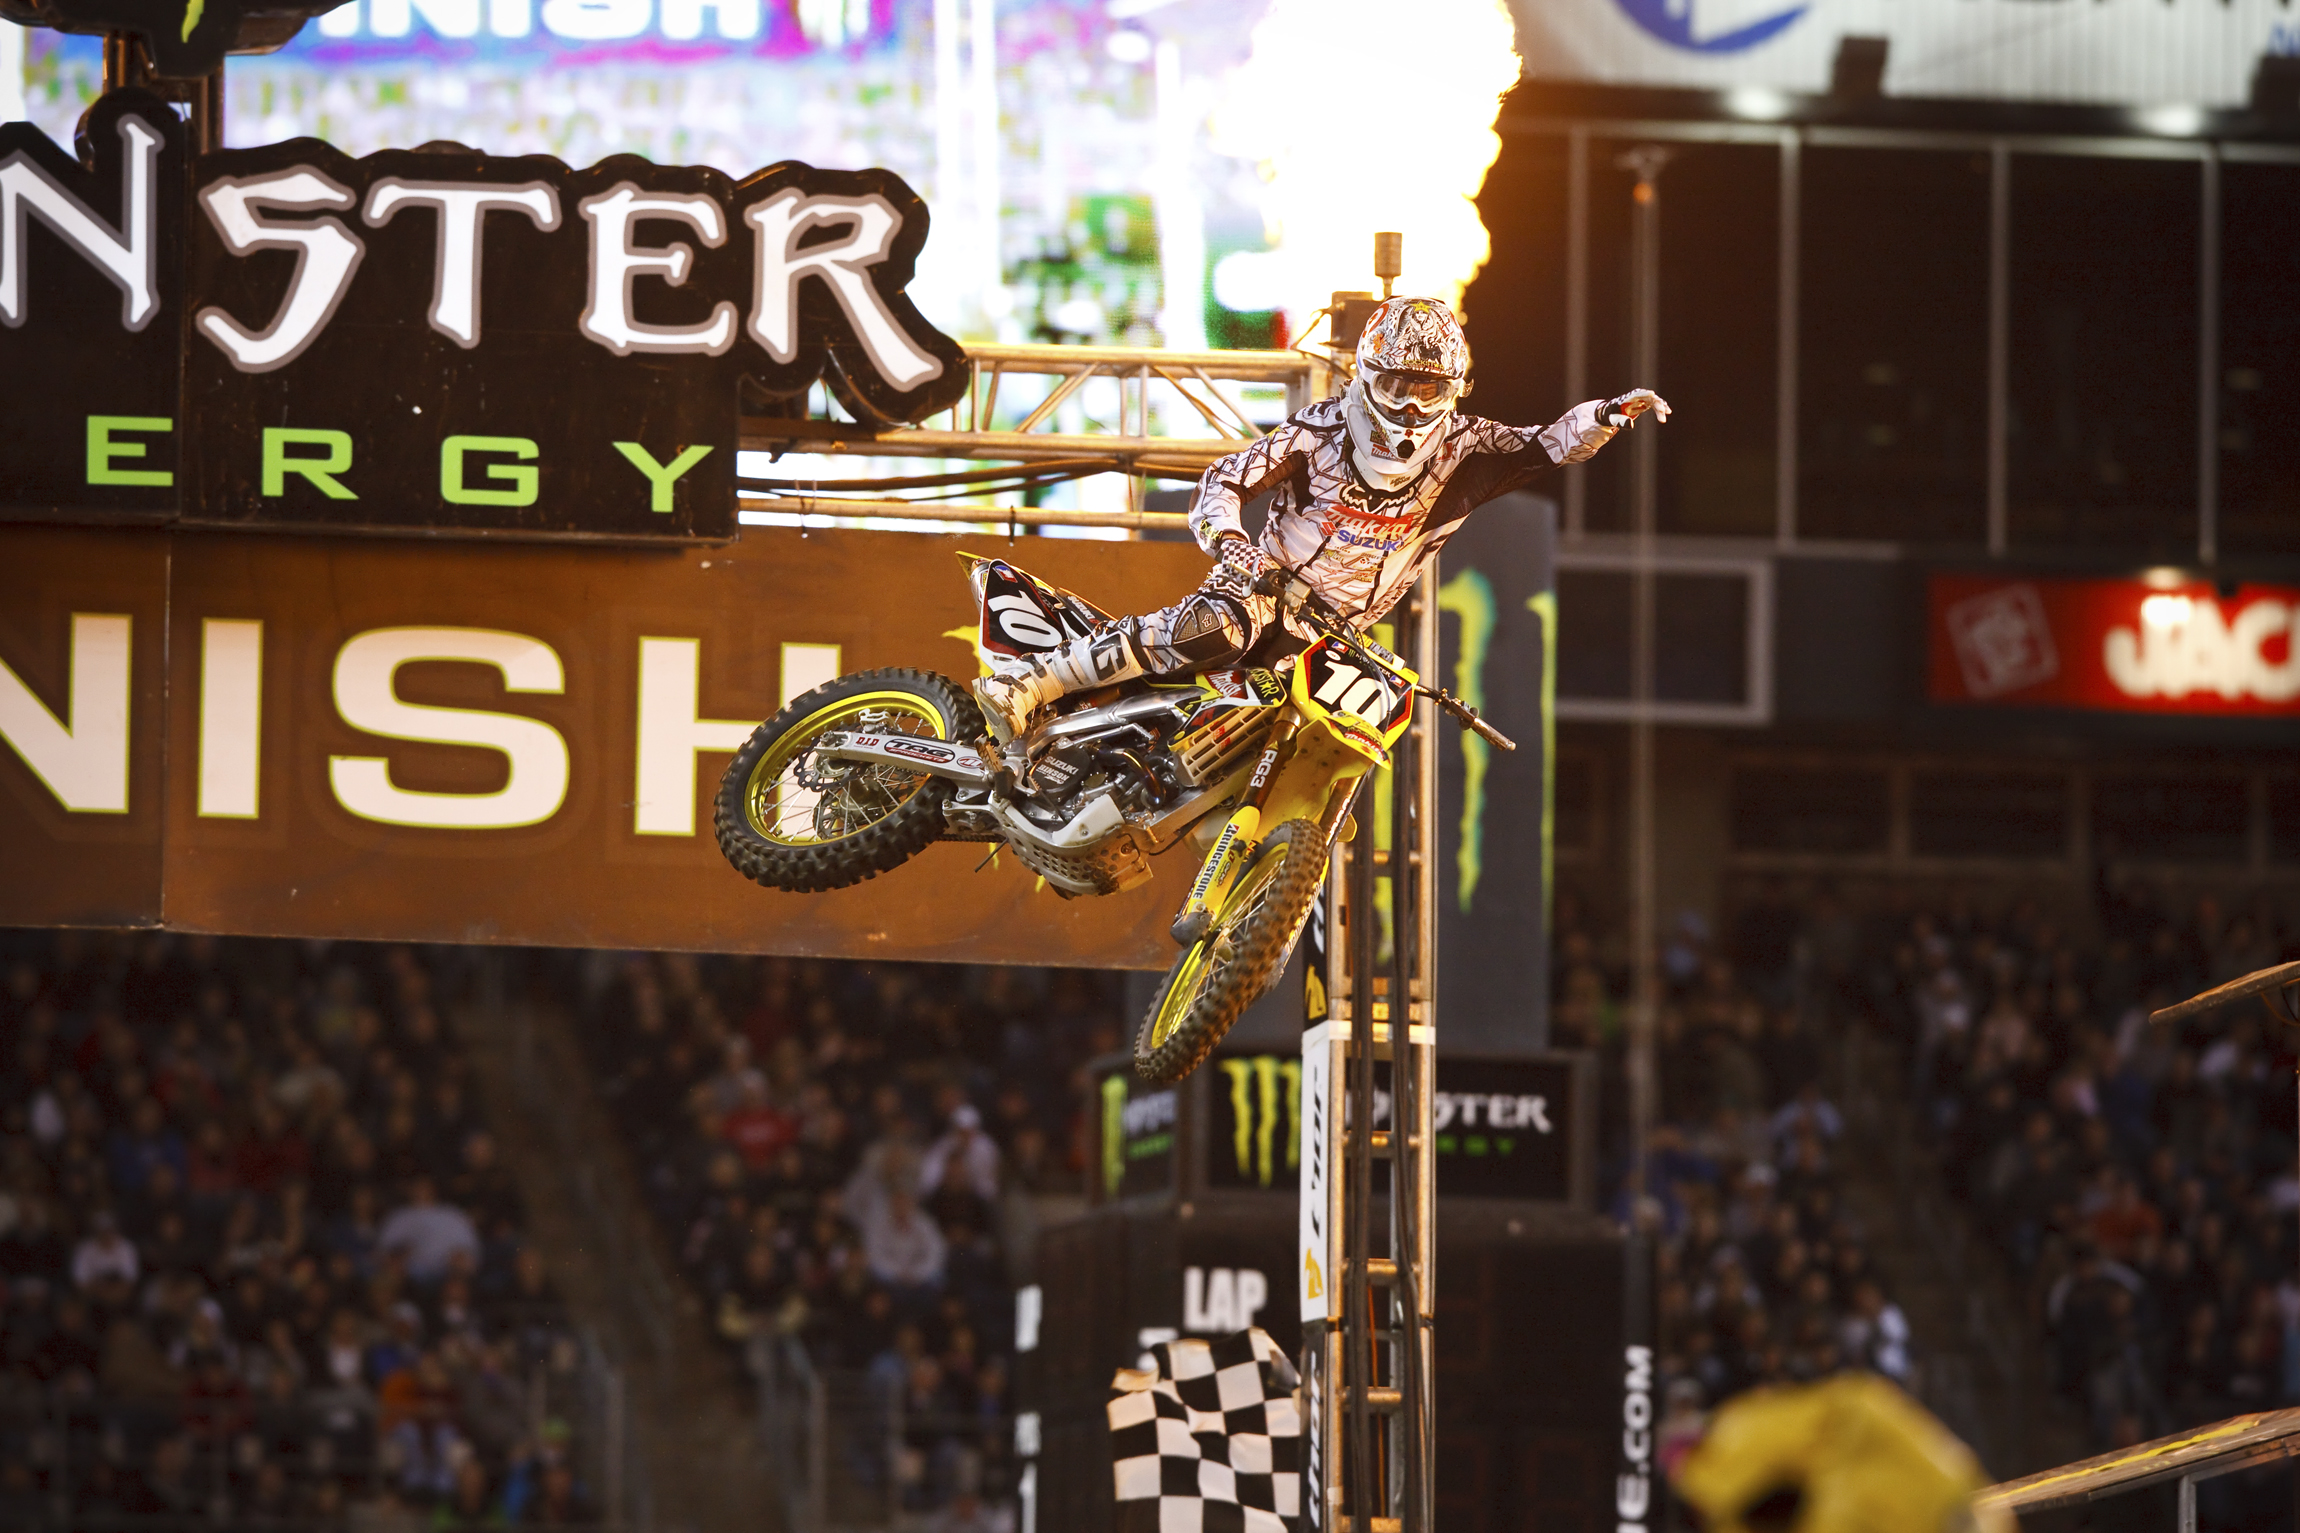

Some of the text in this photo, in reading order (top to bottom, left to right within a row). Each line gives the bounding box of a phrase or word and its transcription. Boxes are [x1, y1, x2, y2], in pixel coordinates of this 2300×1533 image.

[87, 415, 714, 512] ERGY
[987, 590, 1063, 648] 10
[1313, 660, 1398, 728] 10
[1044, 755, 1079, 775] SUZUKI
[1250, 750, 1278, 788] RG3
[1183, 1266, 1268, 1332] LAP
